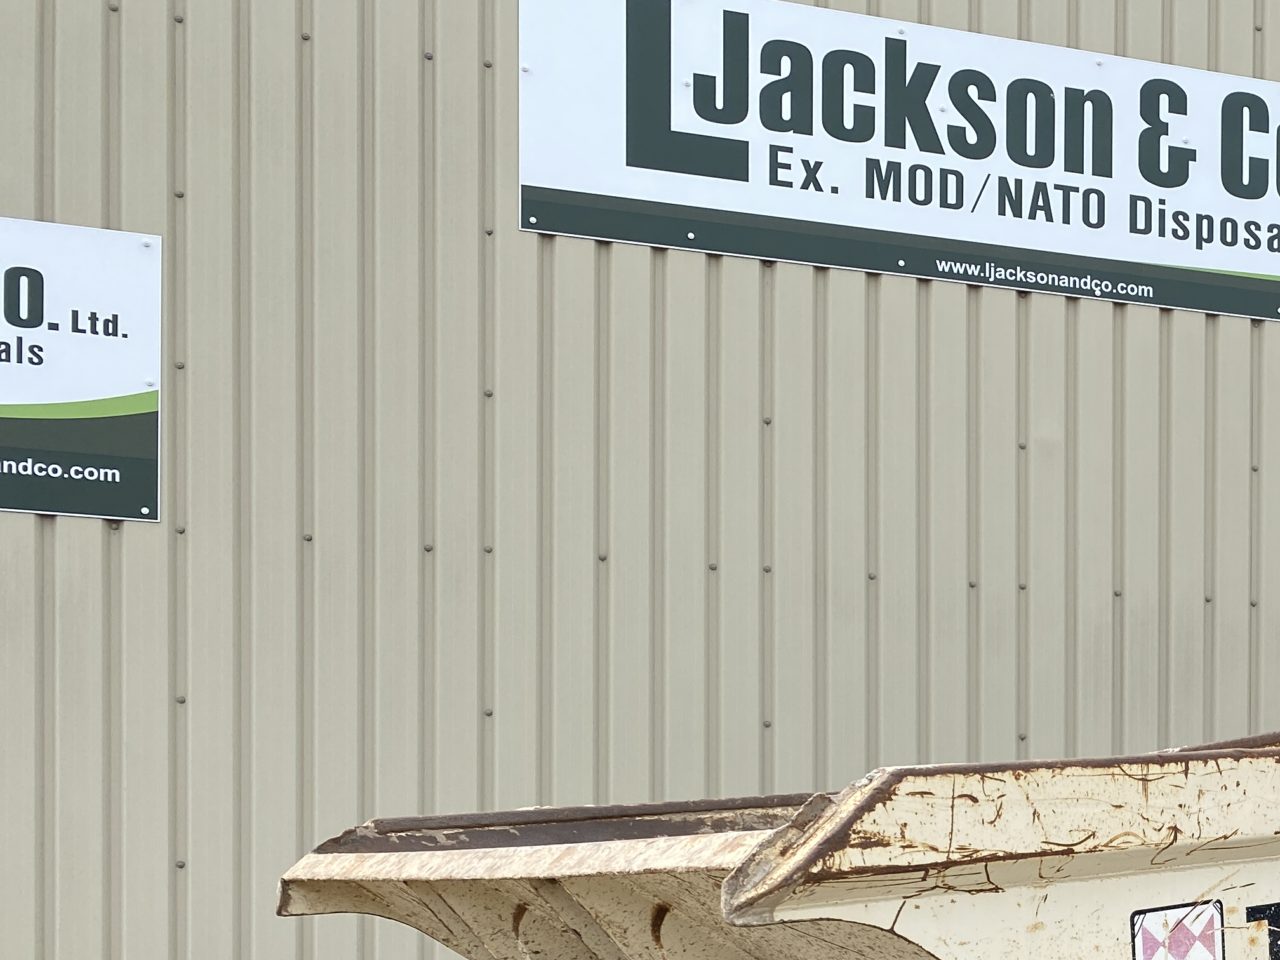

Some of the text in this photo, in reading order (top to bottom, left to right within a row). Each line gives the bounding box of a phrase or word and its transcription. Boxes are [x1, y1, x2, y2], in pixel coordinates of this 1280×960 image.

[1138, 78, 1197, 188] &
[769, 144, 839, 195] Ex.
[865, 157, 1106, 230] MOD/NATO
[936, 259, 1154, 298] www.ljacksonandco.com
[70, 309, 128, 339] Ltd.
[0, 458, 121, 483] ndco.com
